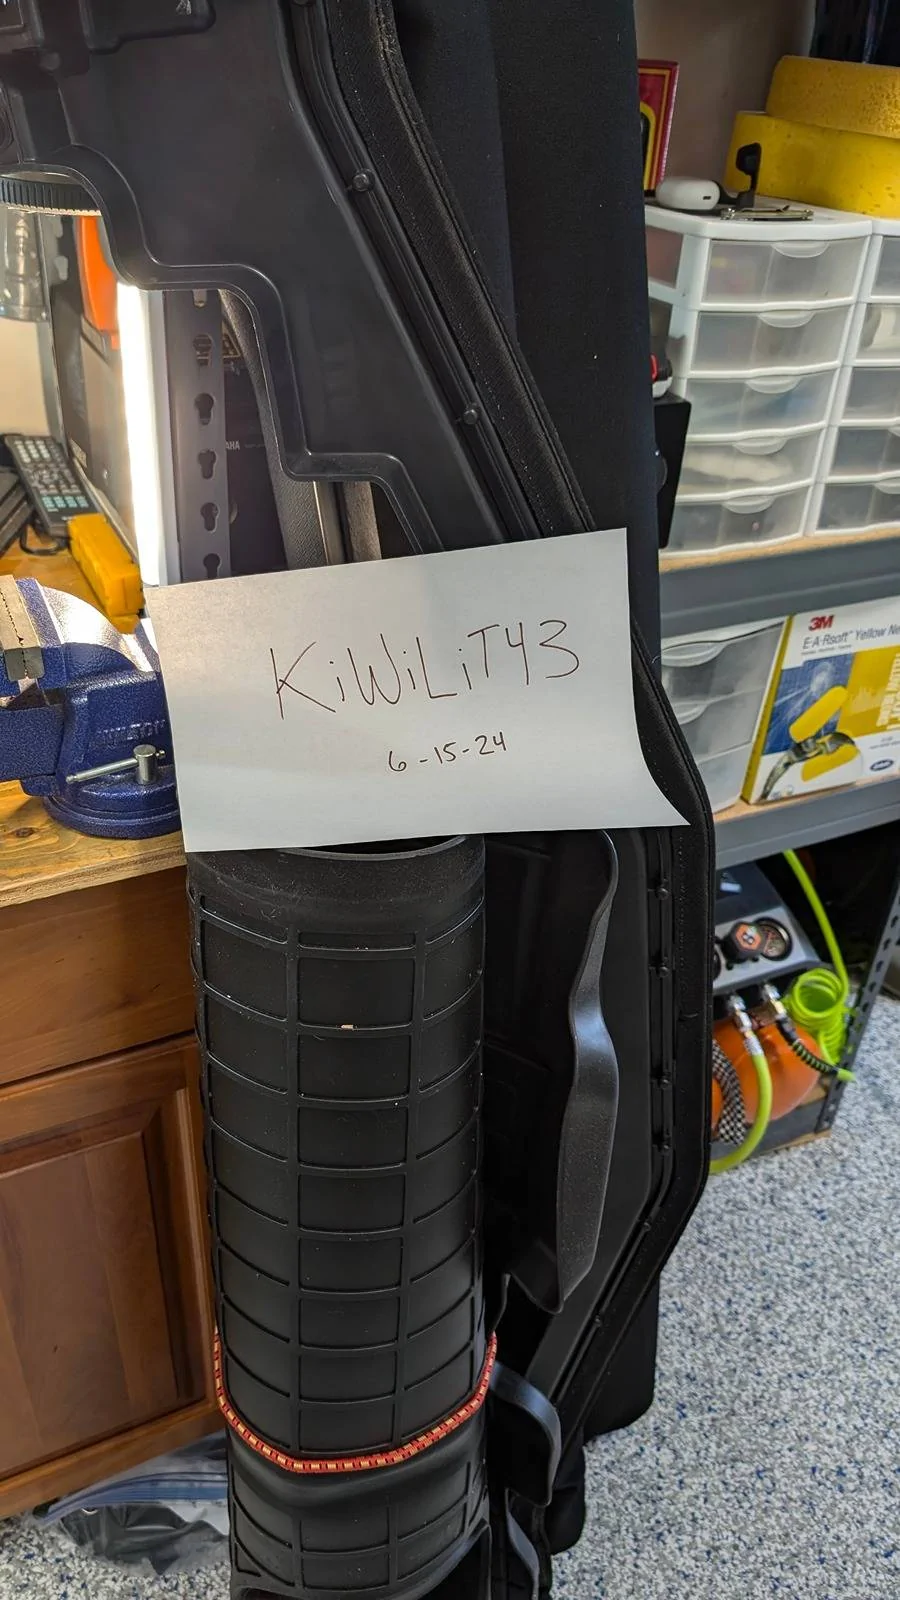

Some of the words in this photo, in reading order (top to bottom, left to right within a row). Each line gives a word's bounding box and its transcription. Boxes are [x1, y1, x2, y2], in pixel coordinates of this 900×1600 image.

[808, 615, 834, 631] 3M
[855, 626, 887, 640] Yellow
[270, 620, 580, 720] KiWiLiT43
[388, 731, 507, 772] 6-15-24
